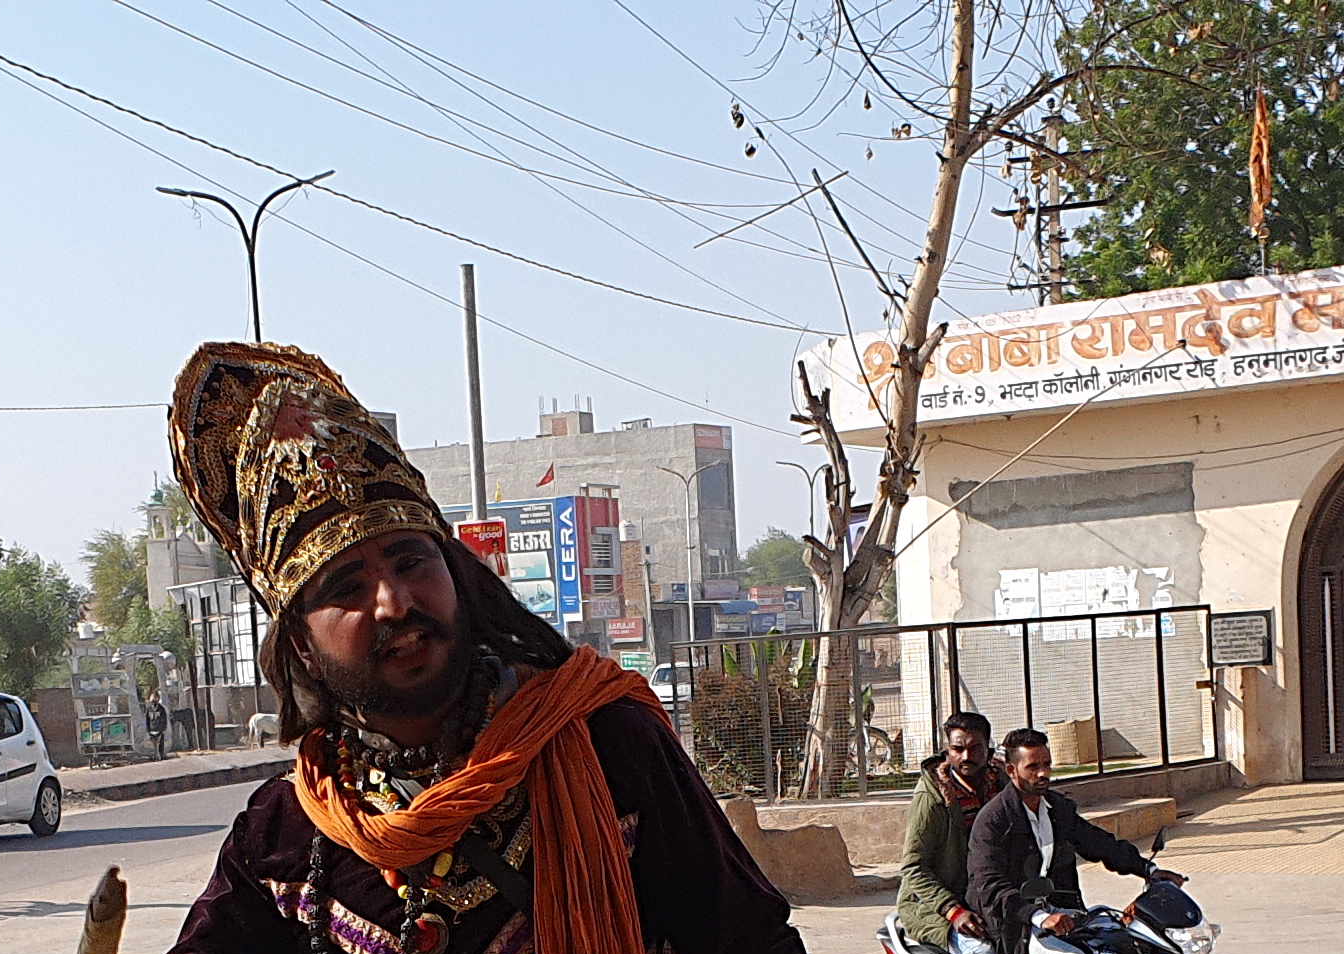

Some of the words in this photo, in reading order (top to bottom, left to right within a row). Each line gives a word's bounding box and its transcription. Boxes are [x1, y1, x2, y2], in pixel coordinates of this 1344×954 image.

[944, 321, 1066, 375] बाबा
[1071, 288, 1283, 360] रामदेव
[920, 385, 950, 409] वार्ड
[560, 507, 576, 581] CERA
